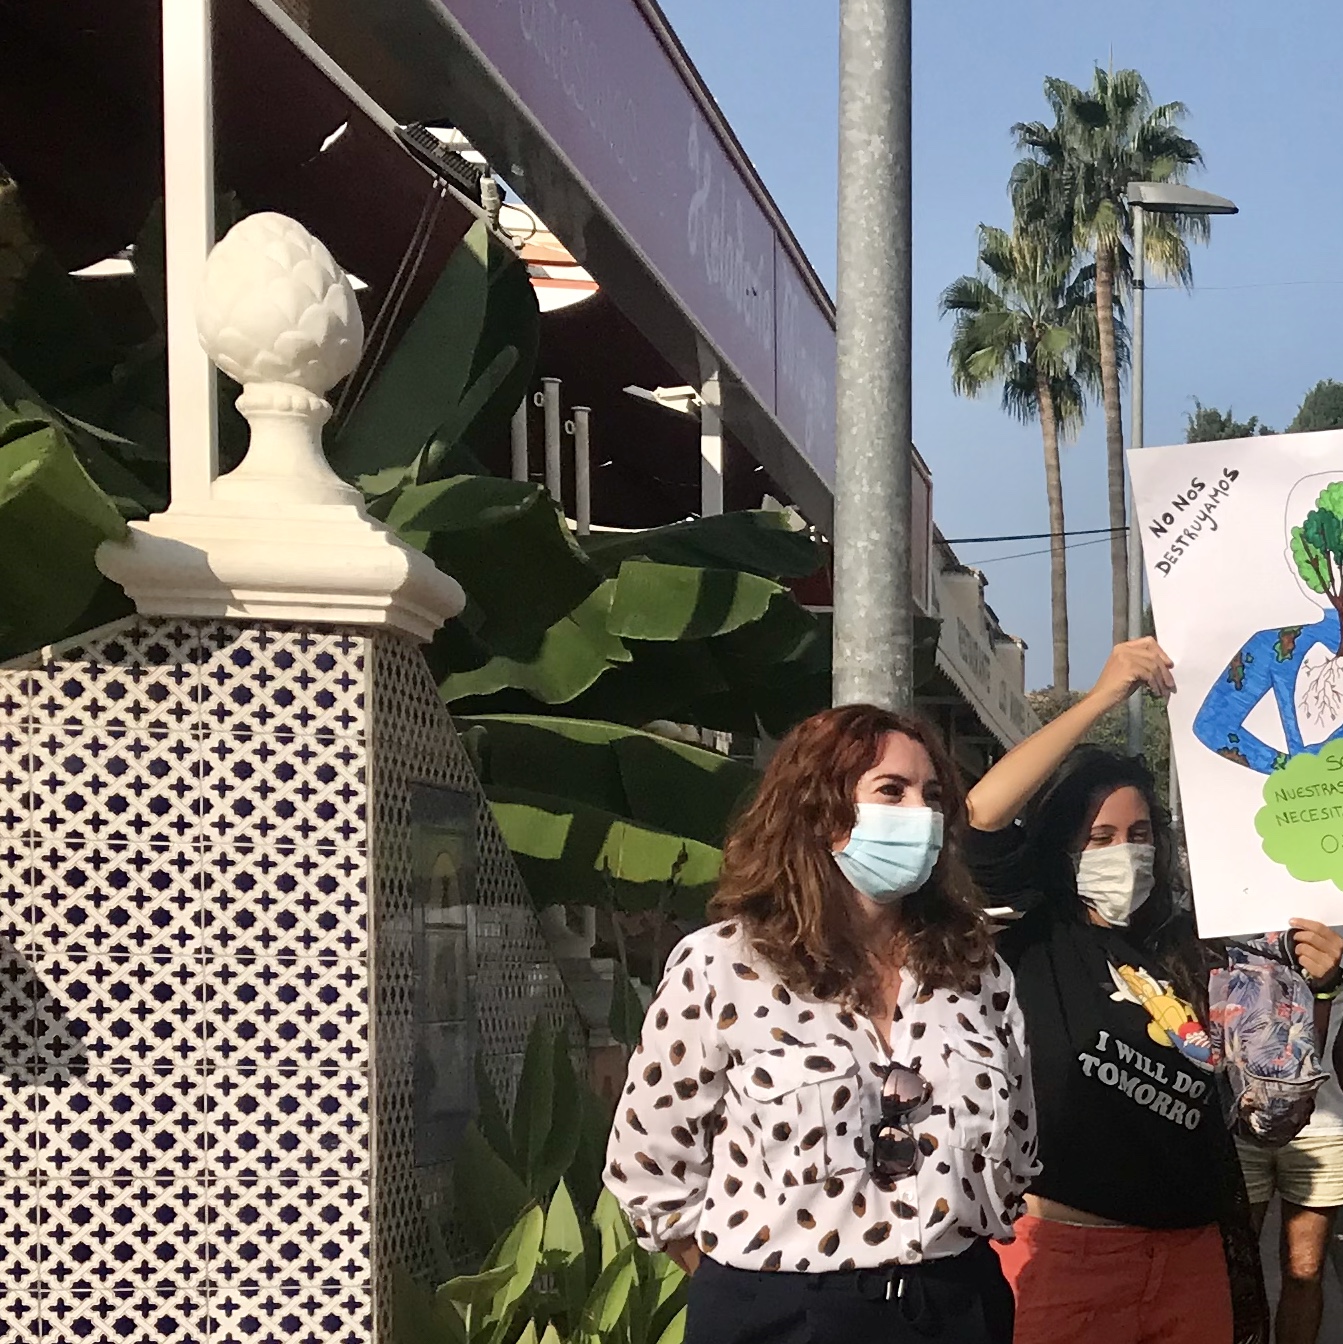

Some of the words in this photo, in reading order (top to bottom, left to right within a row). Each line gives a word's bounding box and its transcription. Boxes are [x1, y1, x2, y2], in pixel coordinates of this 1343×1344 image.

[1148, 512, 1175, 539] NO
[1171, 477, 1206, 512] NOS
[1154, 467, 1240, 578] DESTRUYAMOS
[1095, 1030, 1110, 1052] I
[1115, 1039, 1168, 1085] WILL
[1172, 1070, 1206, 1099] DO
